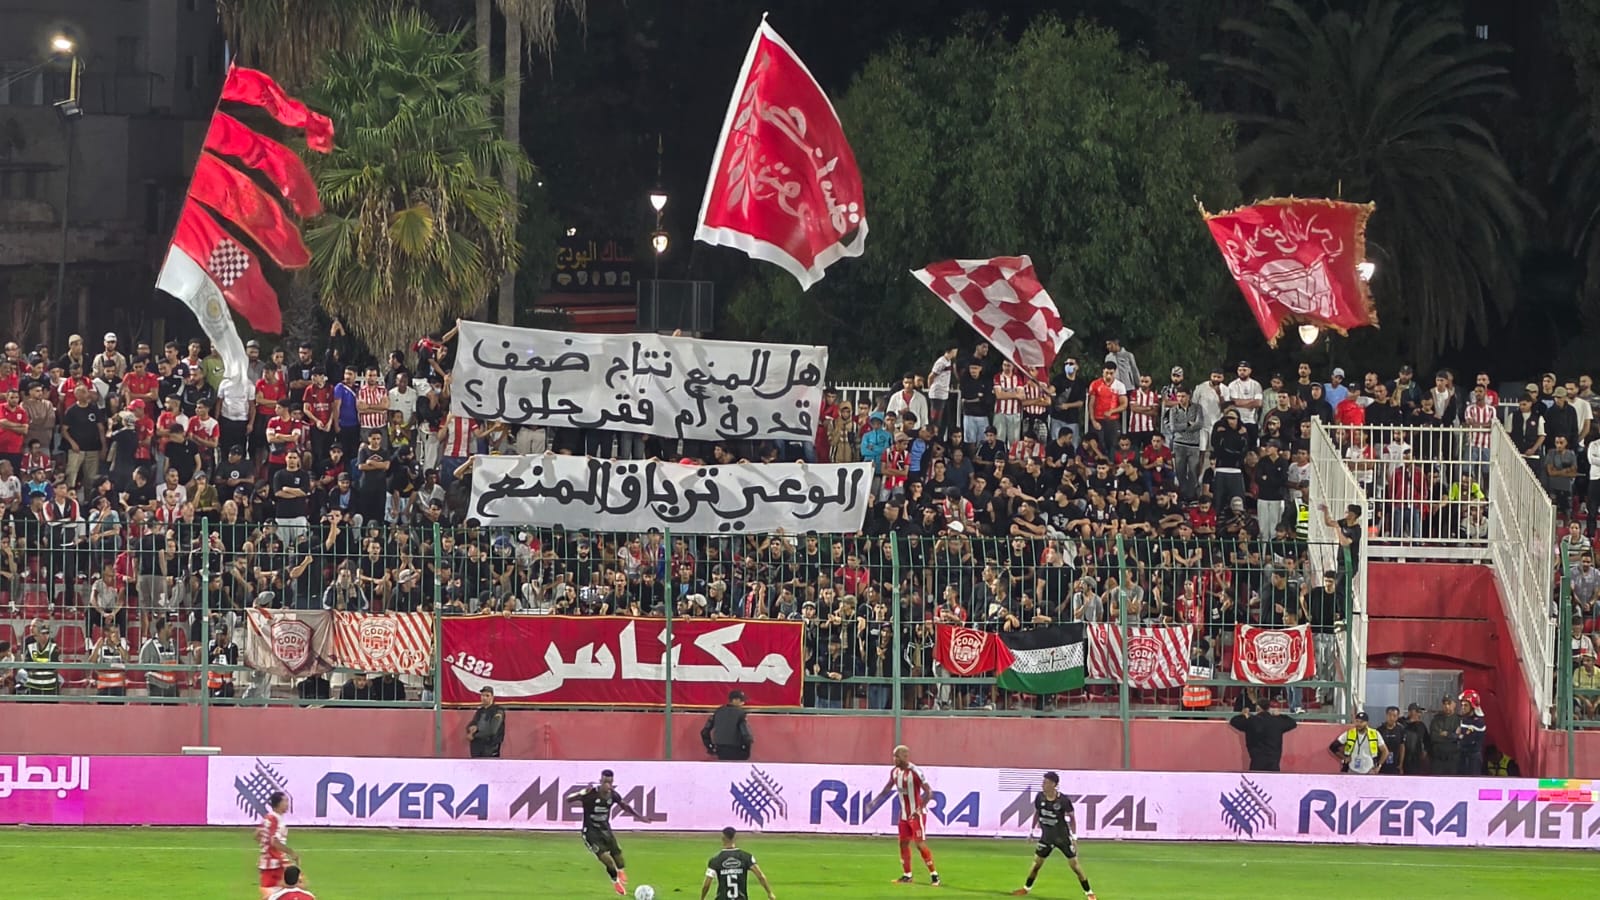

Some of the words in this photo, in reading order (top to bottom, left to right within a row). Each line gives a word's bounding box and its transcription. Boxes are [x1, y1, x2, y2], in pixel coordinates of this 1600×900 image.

[472, 338, 590, 372] ضعف
[605, 341, 673, 389] نتاج
[684, 349, 771, 399] المنع
[752, 349, 821, 399] هل
[567, 388, 654, 428] فقر
[675, 384, 707, 438] أم
[715, 396, 813, 440] قدرة
[477, 458, 612, 518] المنع
[598, 462, 720, 524] ترياق
[709, 467, 863, 532] الوعي
[451, 620, 794, 698] مكناس
[315, 771, 489, 821] RIVERA
[509, 776, 668, 822] MEAL
[811, 779, 981, 828] RIVRA
[1000, 784, 1158, 832] MTAL
[1297, 789, 1468, 838] RIVERA
[726, 874, 739, 899] 5
